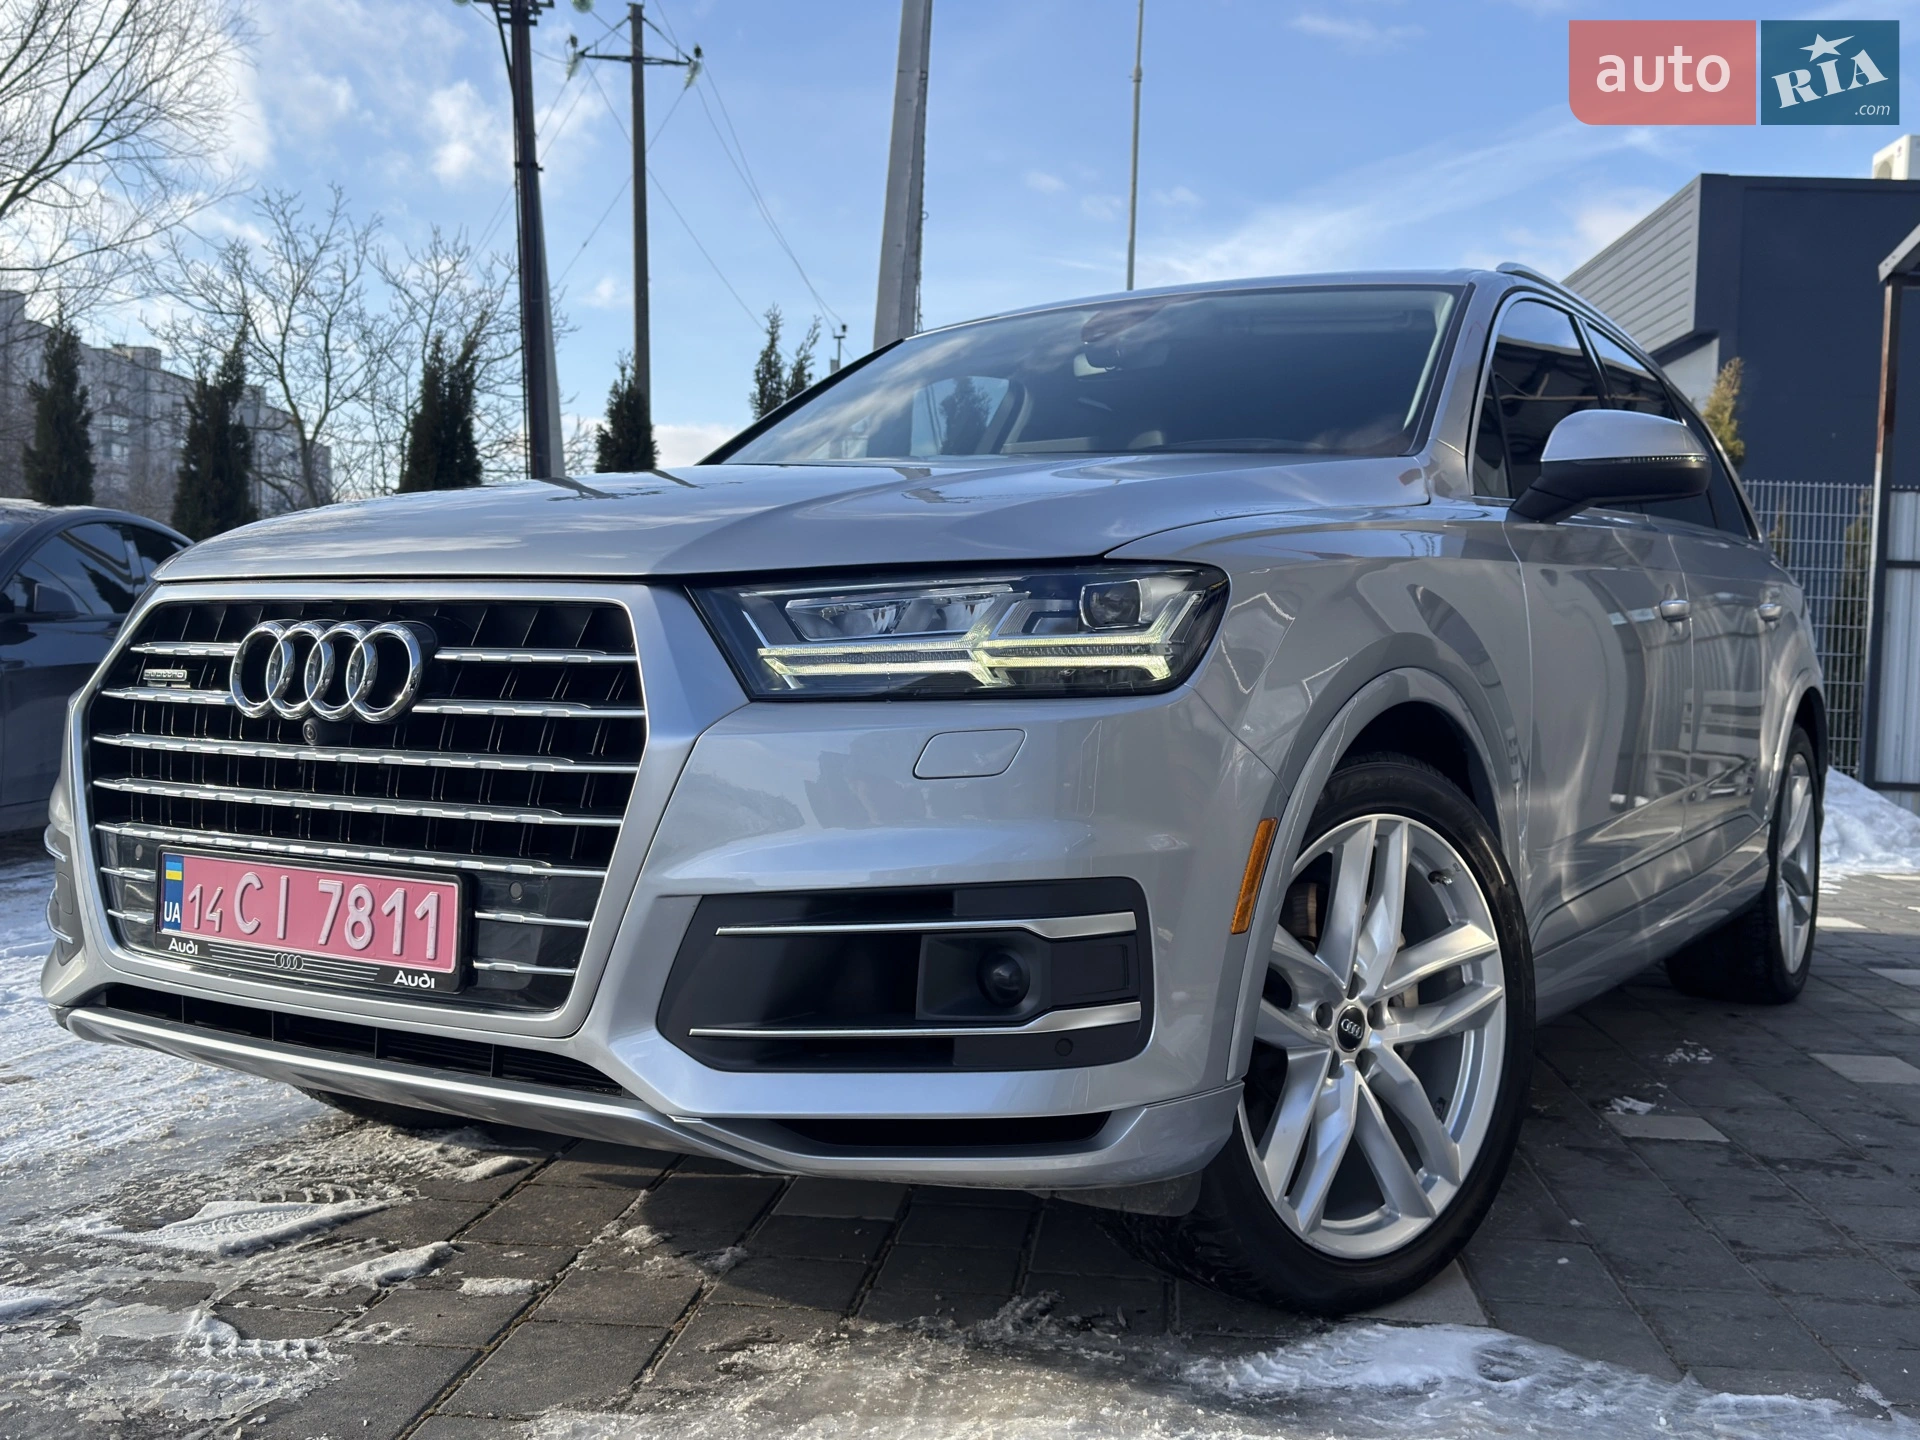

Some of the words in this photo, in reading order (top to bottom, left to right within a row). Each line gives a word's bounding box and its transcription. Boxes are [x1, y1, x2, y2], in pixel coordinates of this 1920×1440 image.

[163, 901, 181, 924] UA
[318, 878, 439, 961] 7811
[168, 937, 199, 956] Audi
[393, 970, 436, 990] Audi
